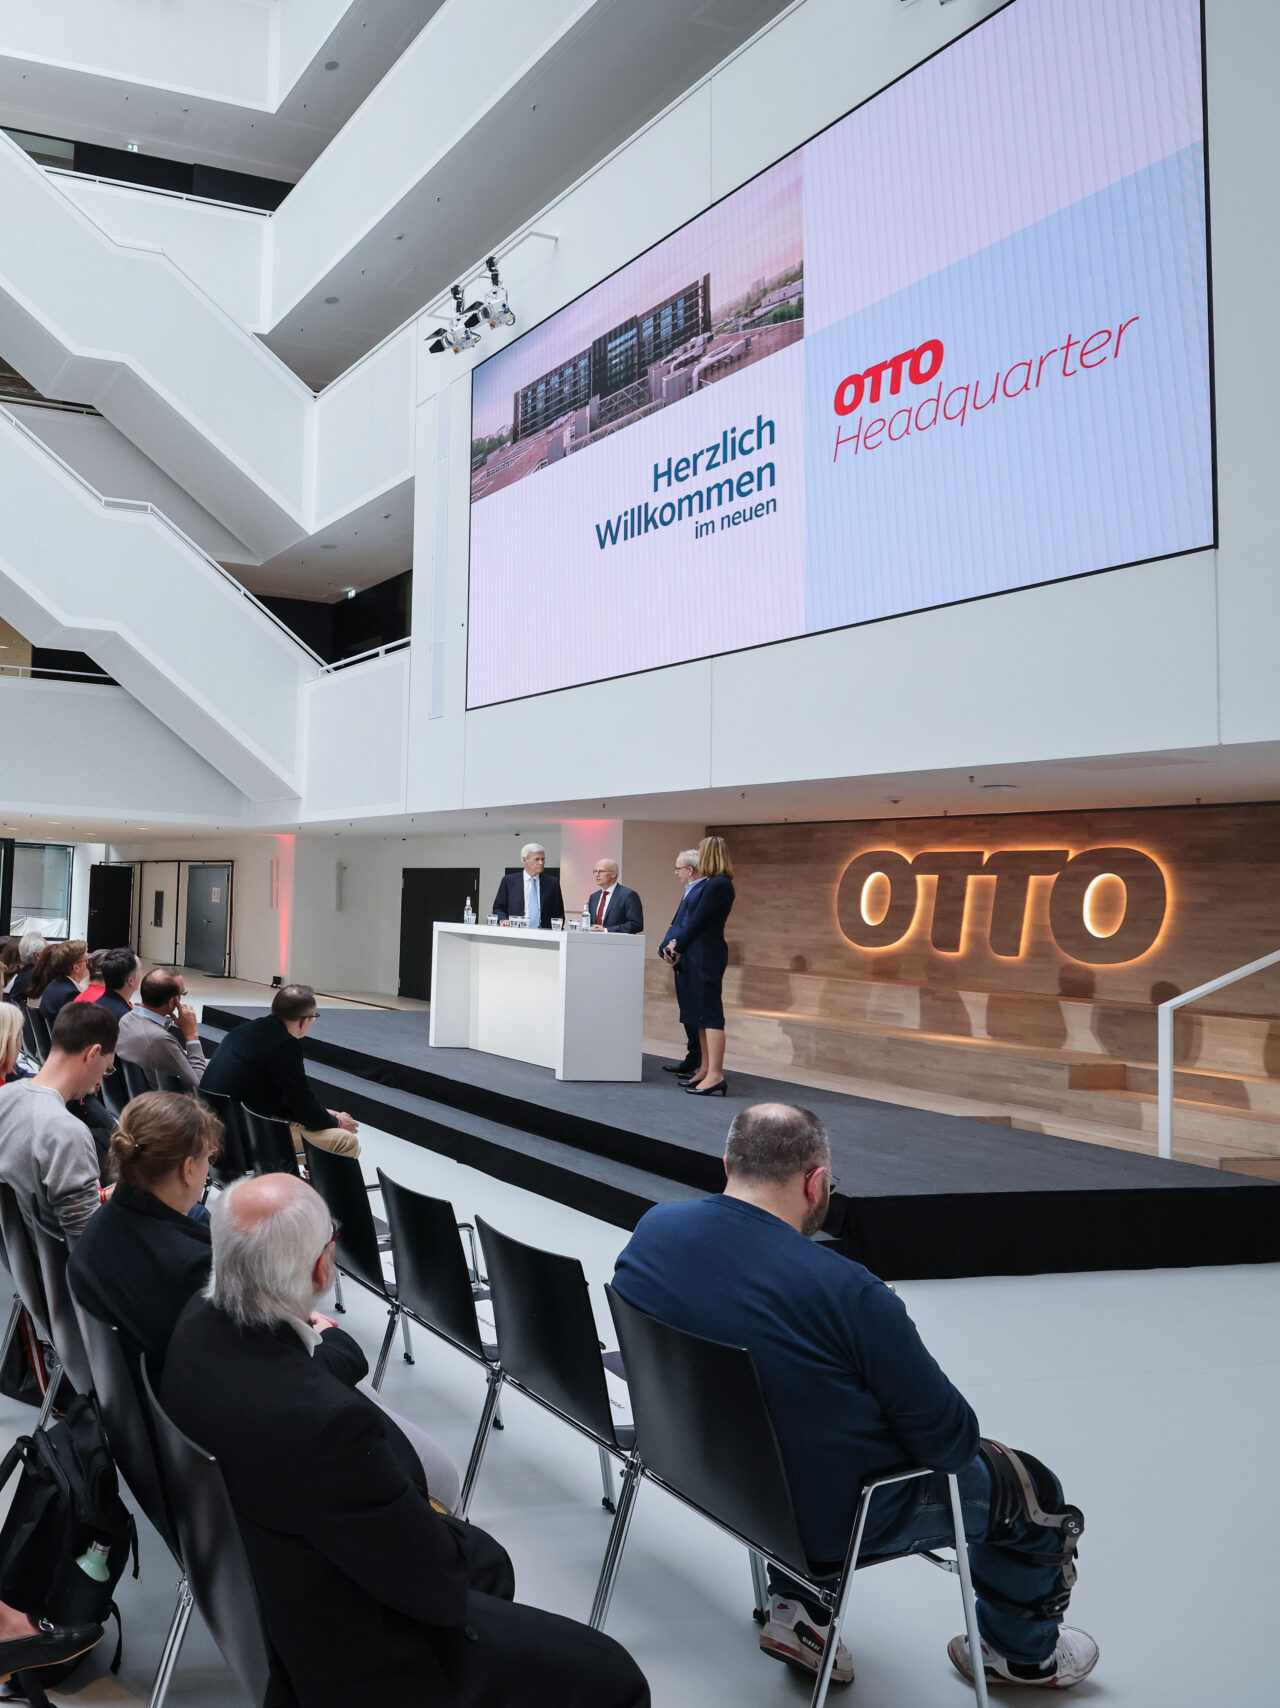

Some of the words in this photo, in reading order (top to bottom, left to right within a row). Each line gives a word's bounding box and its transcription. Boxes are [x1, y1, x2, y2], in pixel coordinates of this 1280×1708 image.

[833, 338, 945, 417] OTTO
[833, 316, 1140, 462] Headquarter
[653, 414, 776, 492] Herzlich
[595, 461, 776, 550] Willkommen
[695, 519, 716, 540] im
[720, 498, 777, 531] neuen
[836, 846, 1167, 966] OTTO
